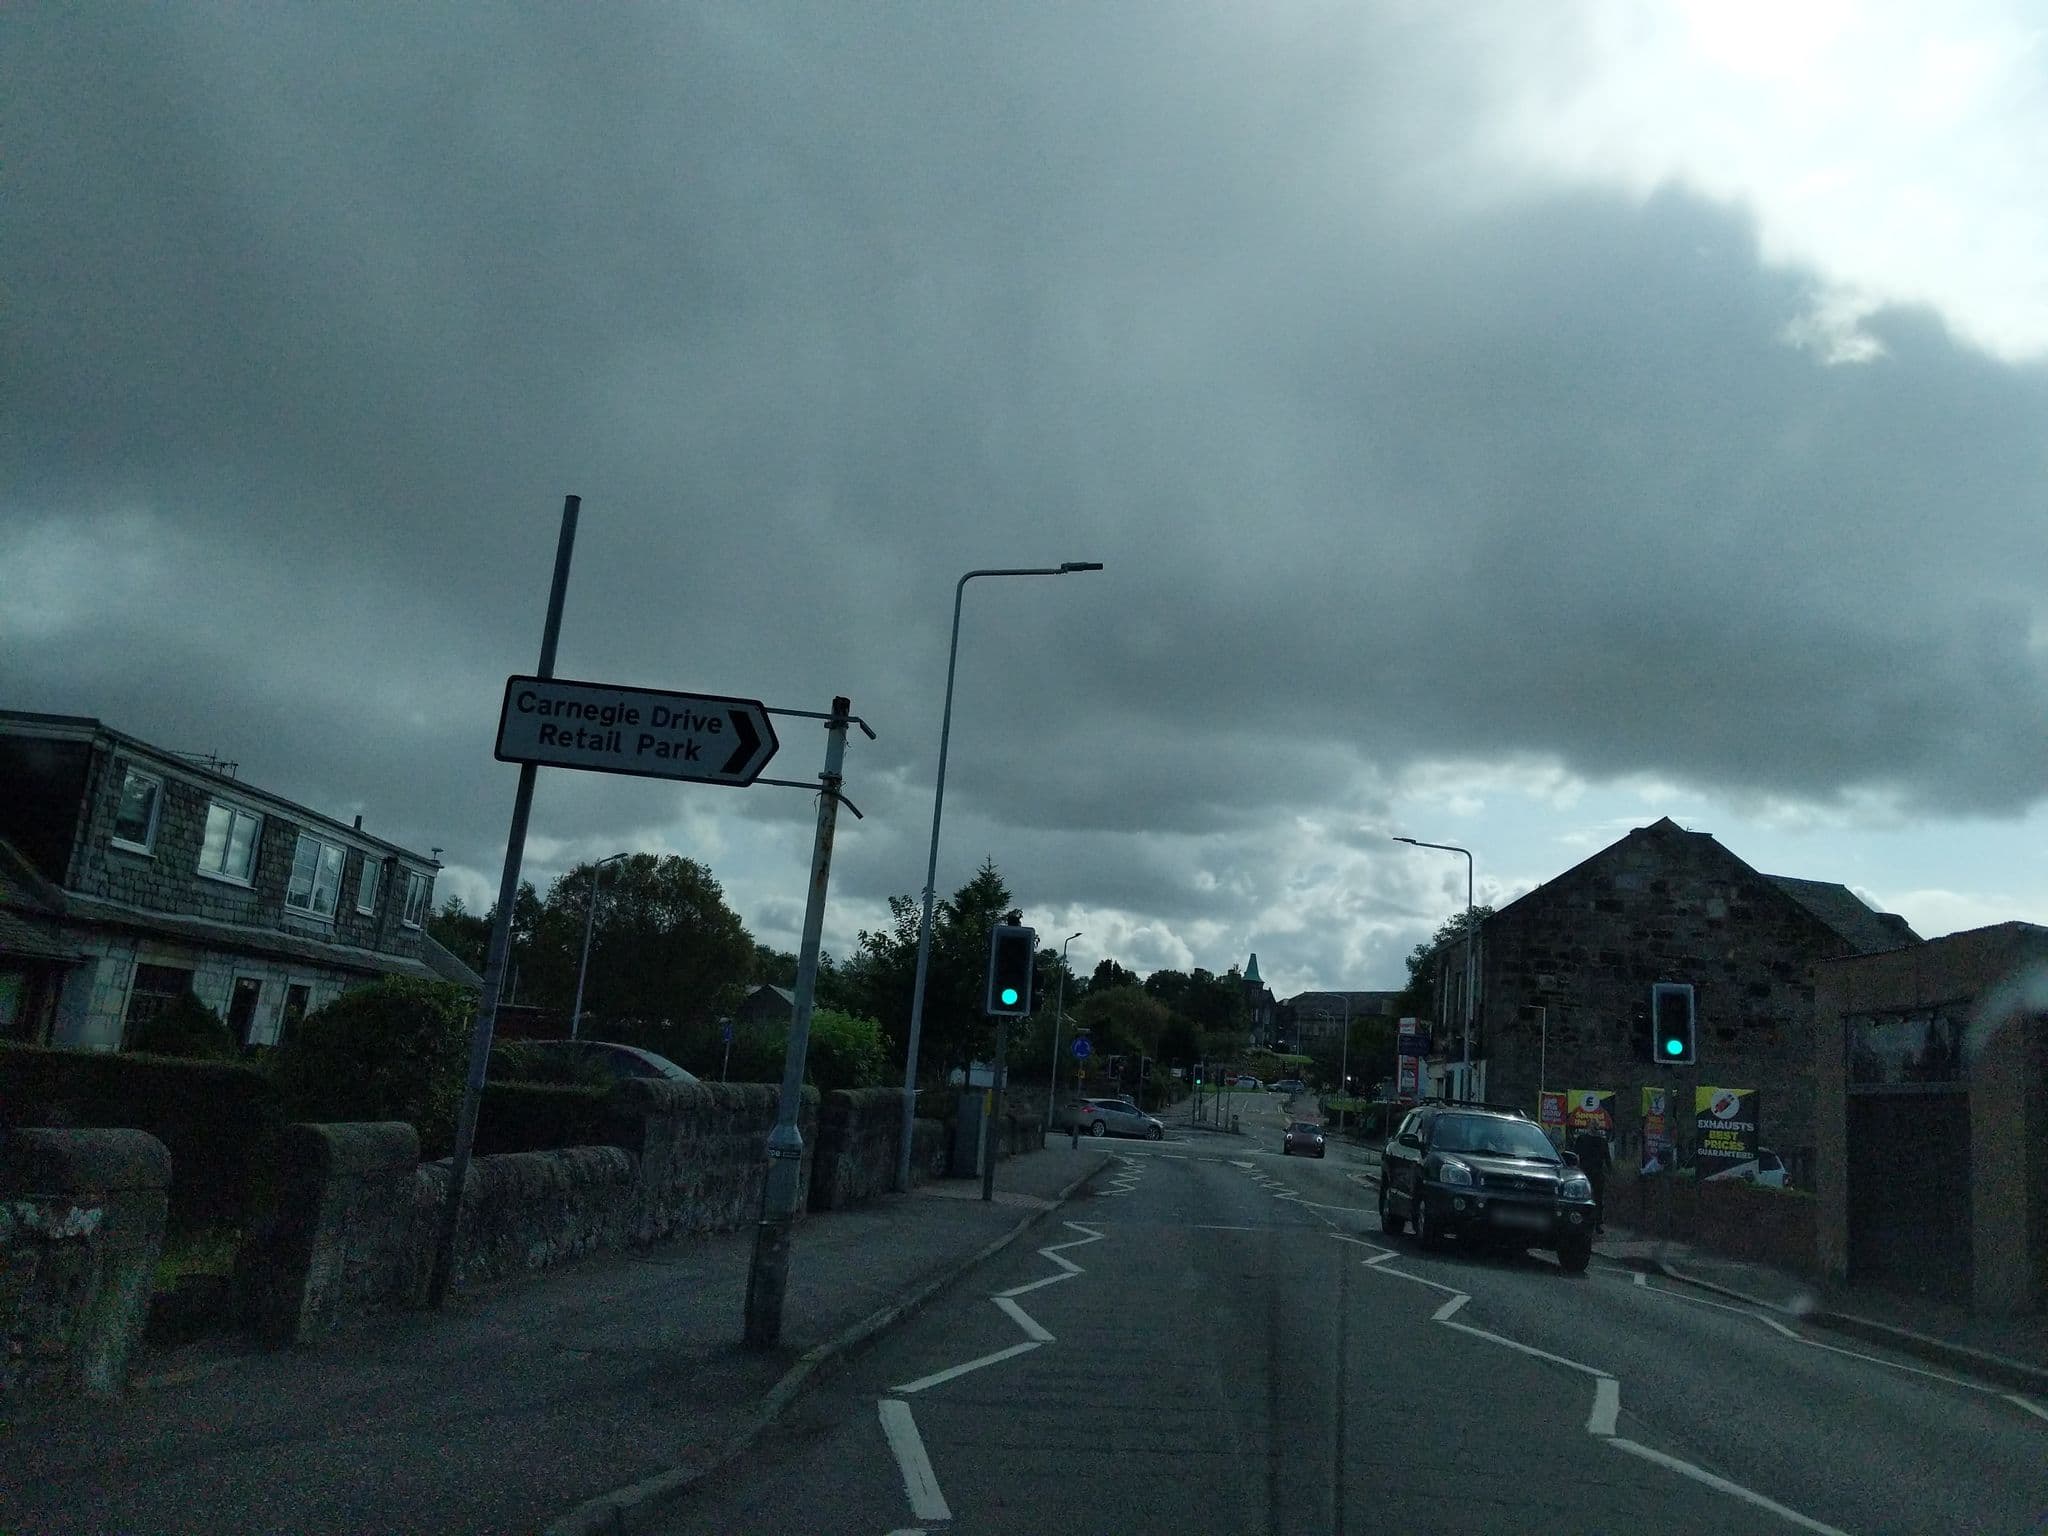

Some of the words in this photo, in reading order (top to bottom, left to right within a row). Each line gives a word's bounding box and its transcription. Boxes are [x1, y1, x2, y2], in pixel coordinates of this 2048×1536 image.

[516, 690, 640, 728] Carnegie
[650, 704, 723, 735] Drive
[538, 722, 621, 754] Retail
[636, 732, 702, 761] Park
[1697, 1119, 1755, 1132] EXHAUSTS
[1708, 1130, 1739, 1141] BEST
[1704, 1139, 1745, 1152] PRICES
[1697, 1148, 1754, 1159] GUARANTEED
